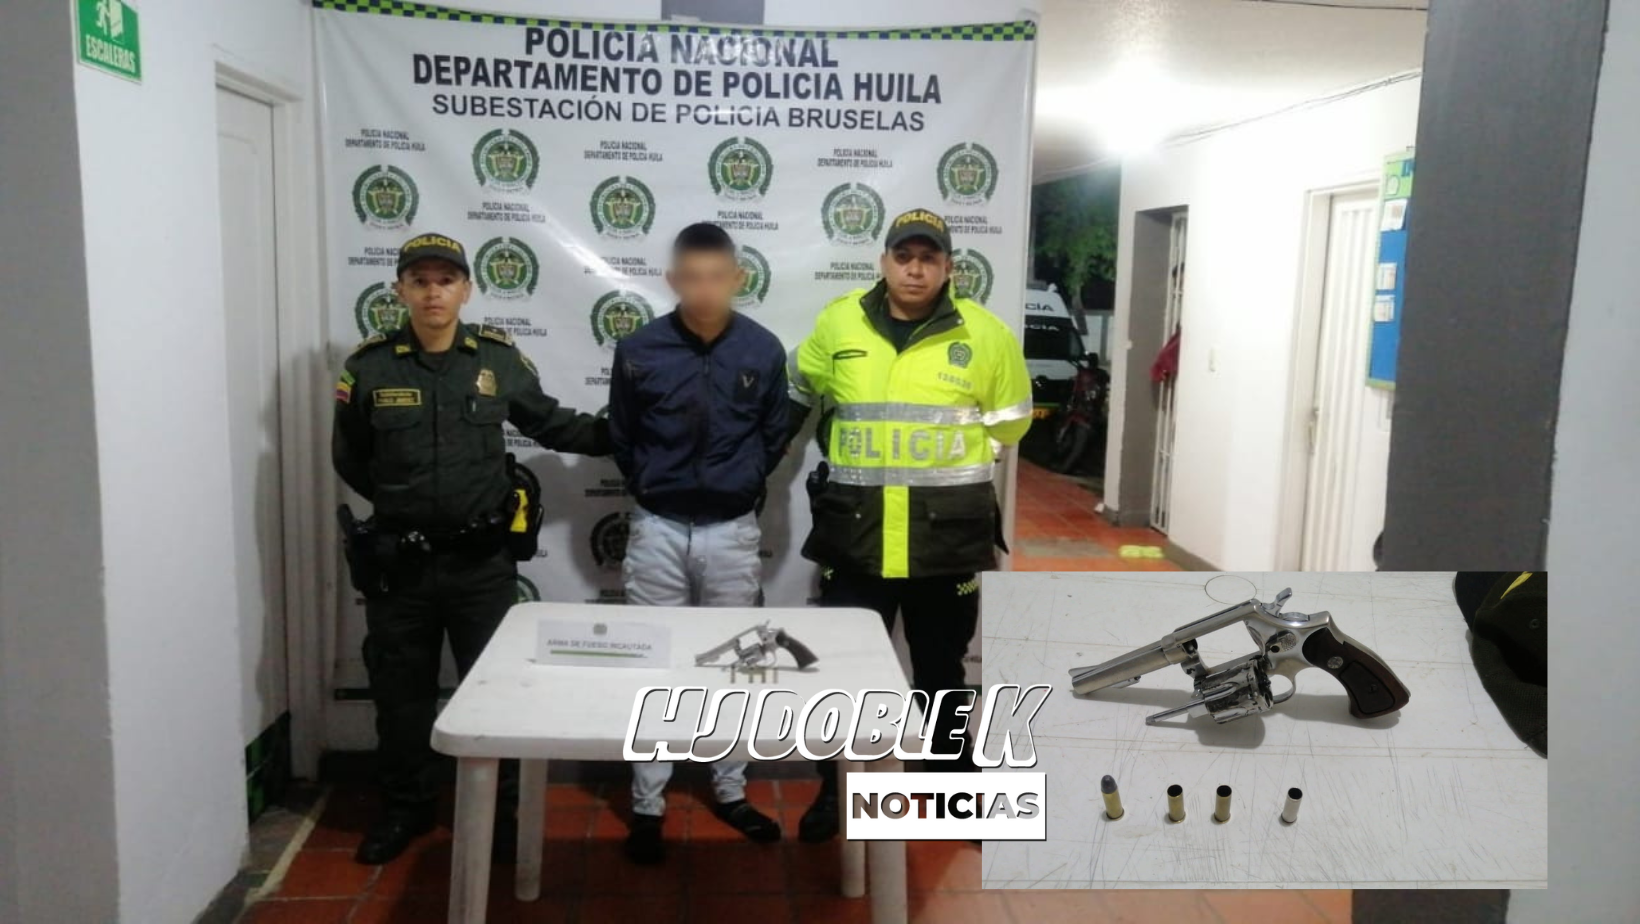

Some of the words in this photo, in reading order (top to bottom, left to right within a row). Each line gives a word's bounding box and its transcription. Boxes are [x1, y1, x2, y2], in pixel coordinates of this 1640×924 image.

[86, 34, 136, 73] ESCALERAS
[525, 27, 659, 63] POLICIA
[670, 34, 839, 68] NACIONAL
[413, 54, 662, 96] DEPARTAMENTO
[674, 70, 712, 97] DE
[723, 72, 843, 101] POLICIA
[854, 73, 942, 104] HUILA
[432, 94, 622, 122] SUBESTACIÓN
[631, 102, 667, 123] DE
[788, 107, 924, 131] BRUSELAS
[895, 211, 944, 233] POLICIA
[404, 236, 461, 253] POLICIA
[840, 427, 966, 460] POLICIA
